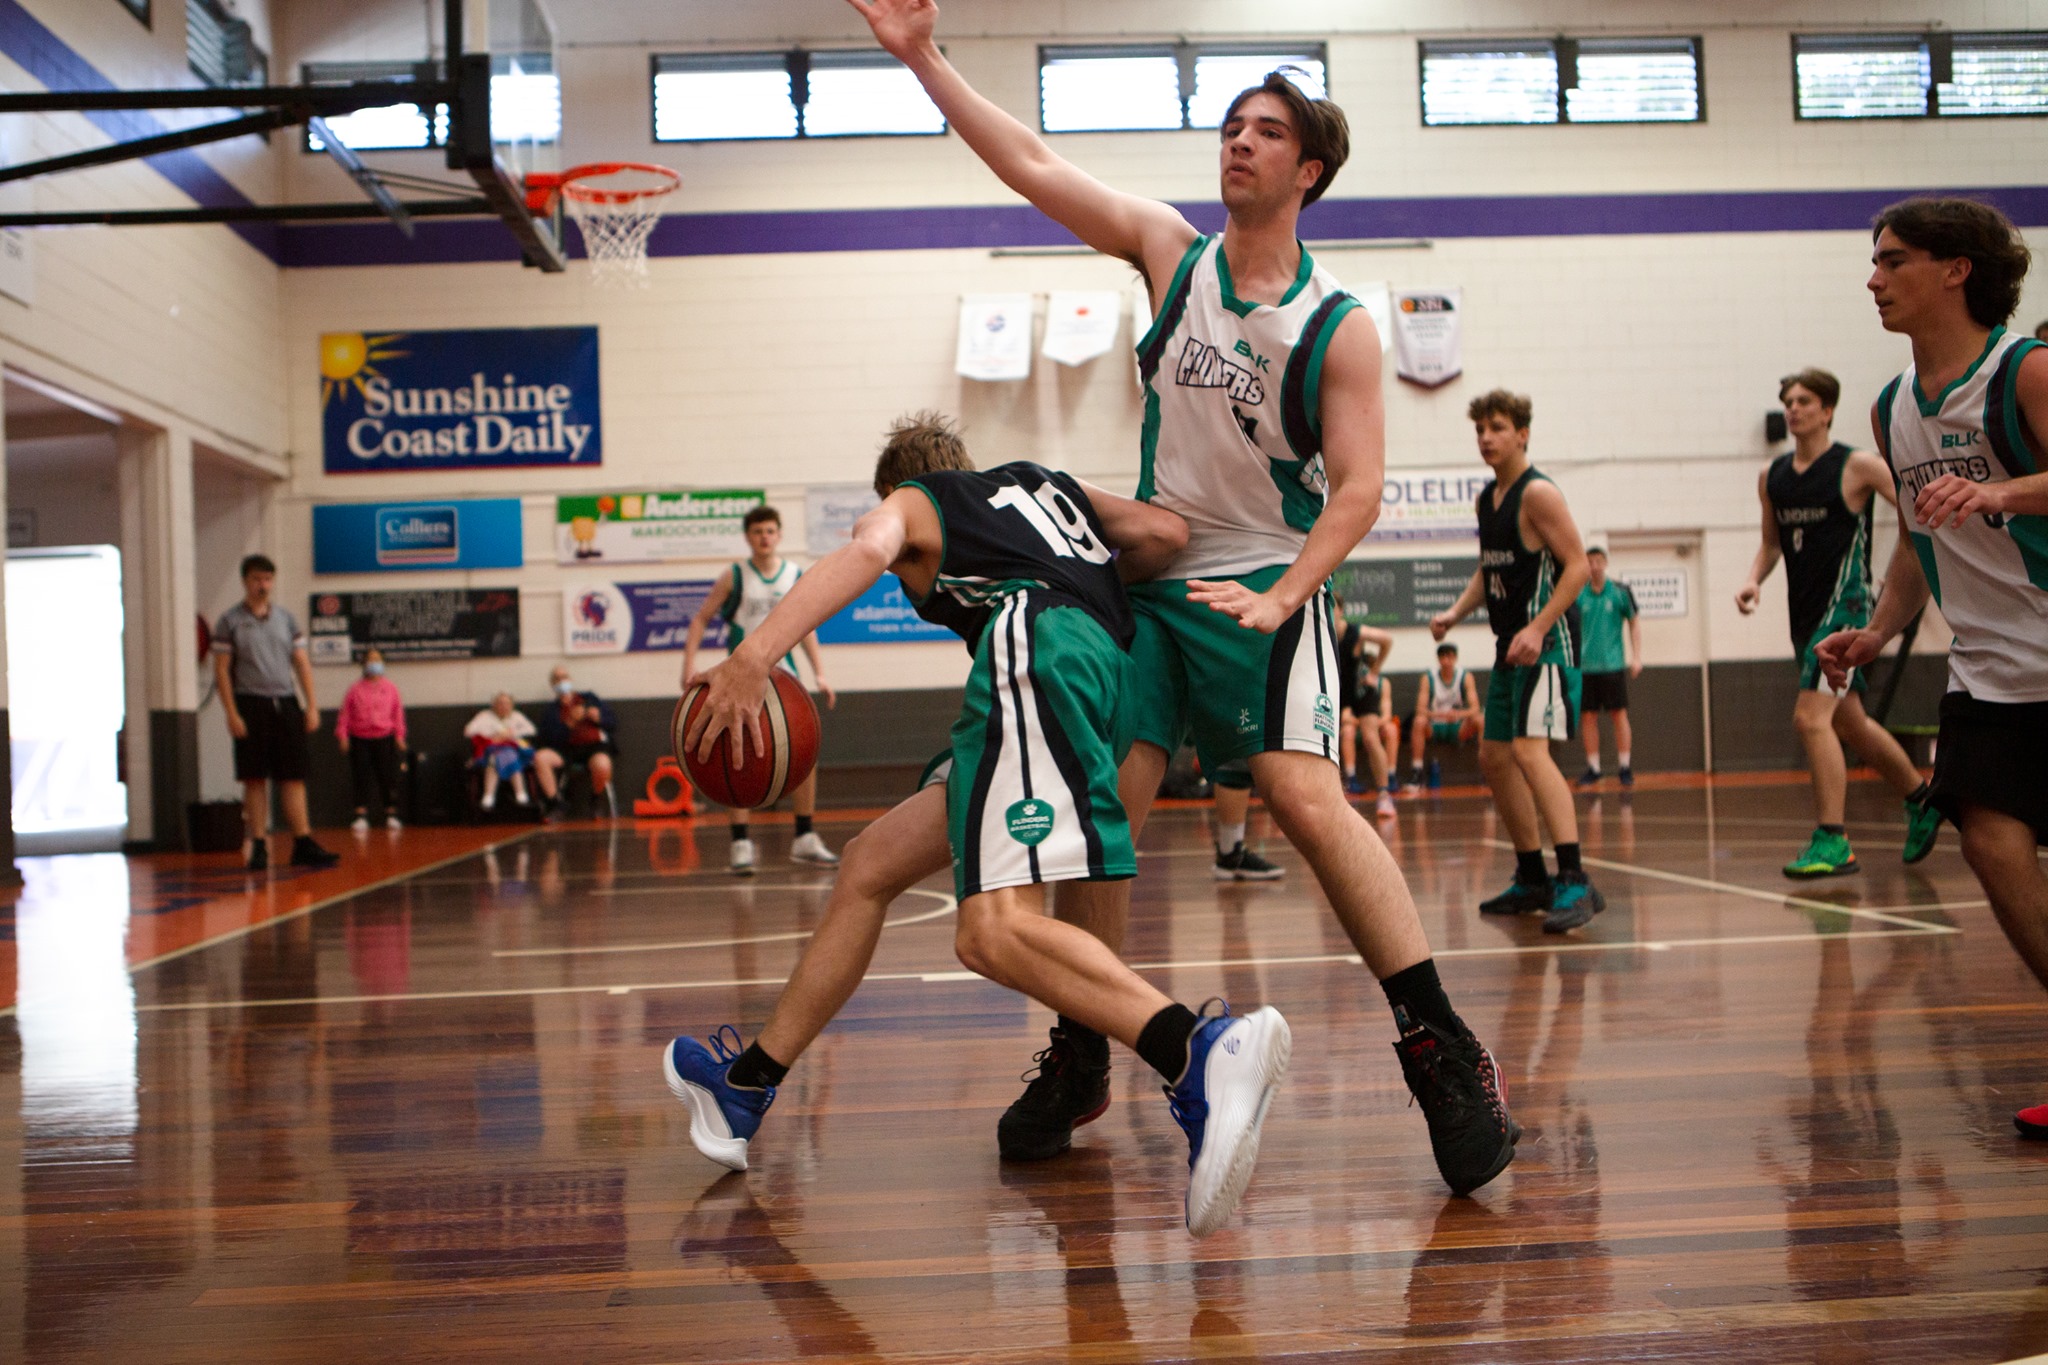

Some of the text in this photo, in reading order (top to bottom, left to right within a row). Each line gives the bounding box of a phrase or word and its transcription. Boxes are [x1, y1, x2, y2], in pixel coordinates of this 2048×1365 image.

[364, 372, 571, 417] Sunshine
[347, 411, 592, 461] Coast Daily
[1941, 430, 1981, 448] BLK
[385, 517, 450, 535] Colliers
[631, 523, 744, 537] MAROOCHYDO
[987, 481, 1112, 565] 19
[1638, 590, 1678, 598] HANGE
[572, 630, 616, 642] PRIDE
